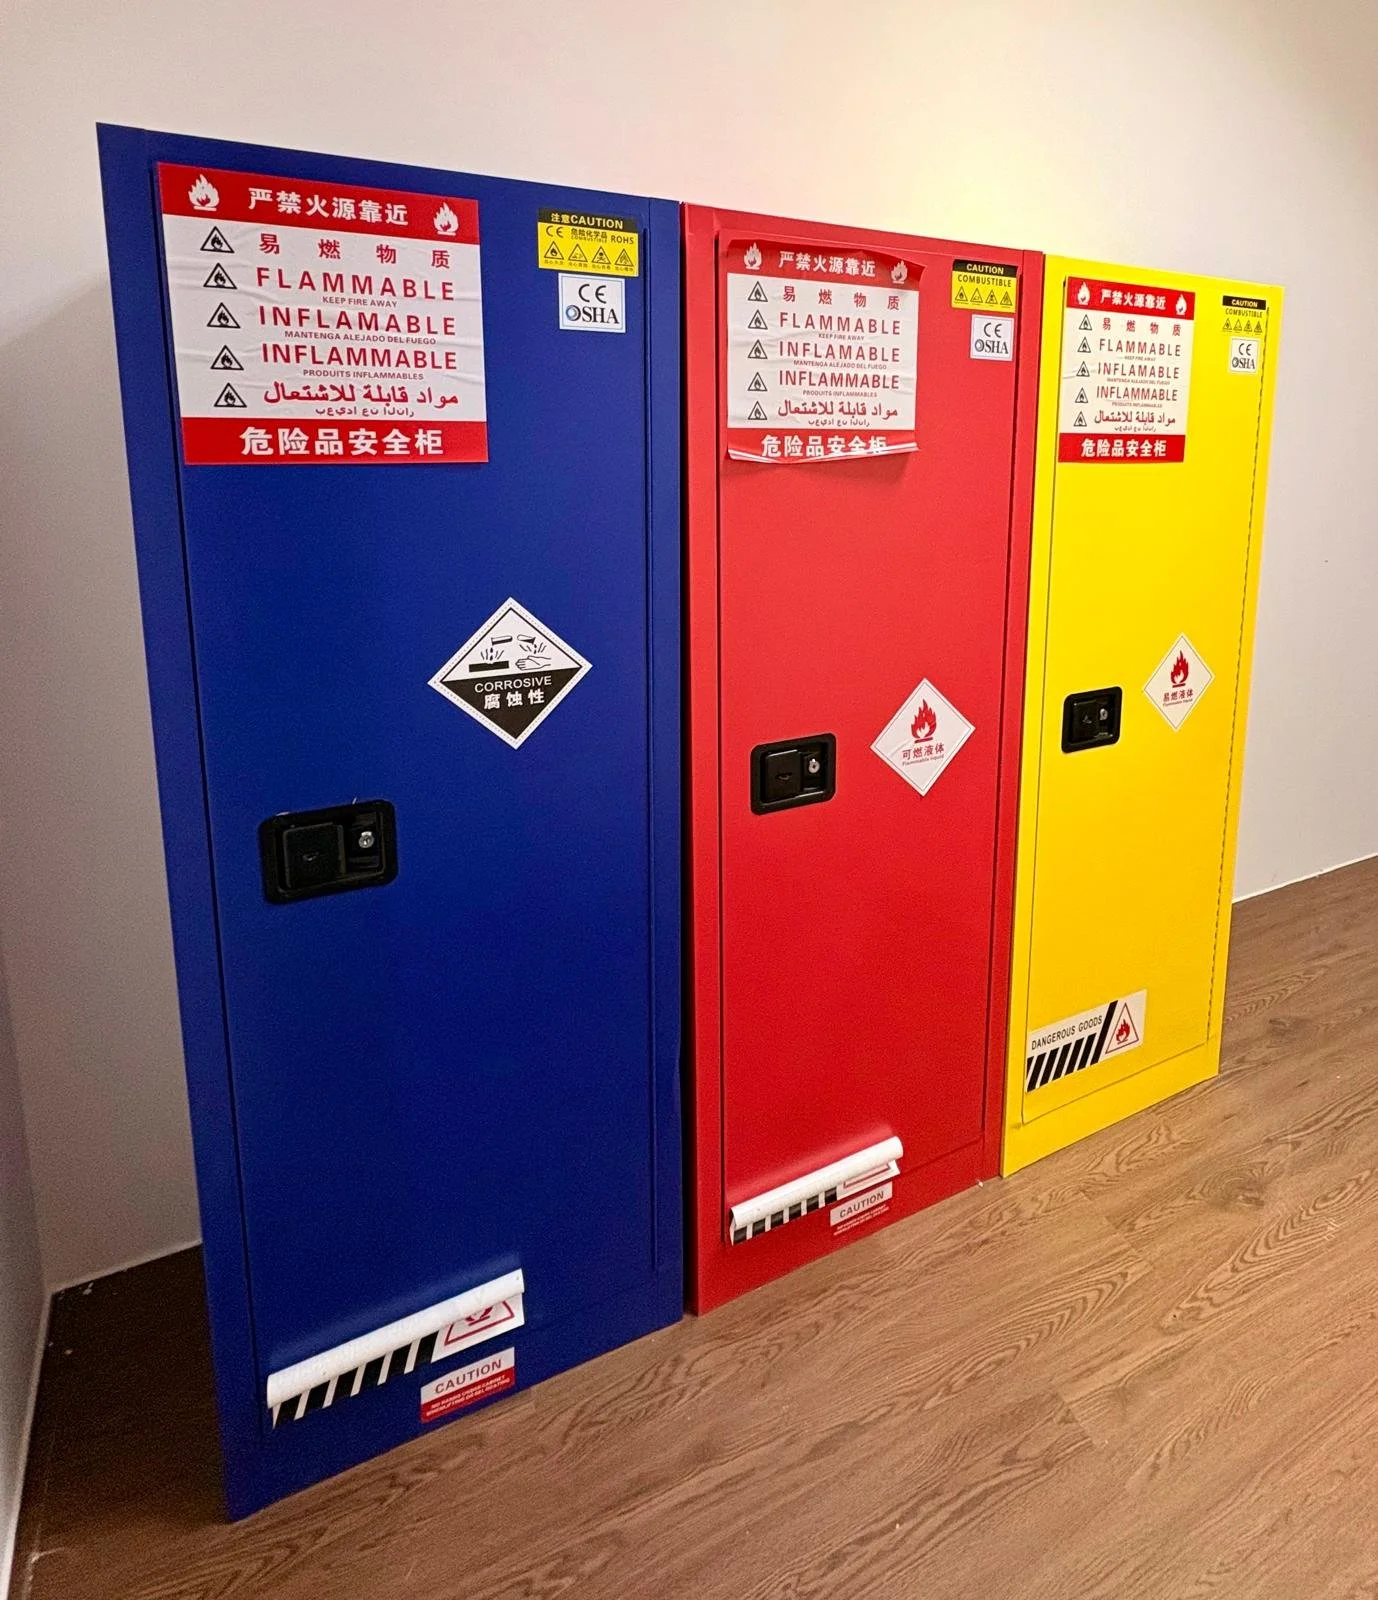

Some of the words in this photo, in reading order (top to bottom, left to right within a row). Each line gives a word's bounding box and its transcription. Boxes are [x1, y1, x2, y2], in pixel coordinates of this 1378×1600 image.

[248, 187, 408, 226] 严禁火源靠近
[611, 235, 634, 245] ROHS
[778, 250, 876, 277] 严禁火源靠近
[966, 263, 1004, 276] CAUTION
[256, 266, 454, 301] FLAMMABLE
[957, 274, 1012, 288] COMBUSTIBLE
[322, 296, 346, 305] KEEP
[348, 297, 368, 306] FIRE
[370, 299, 398, 308] AWAY
[578, 283, 607, 304] CE
[1100, 288, 1166, 310] 严禁火源靠近
[1231, 299, 1258, 308] CAUTION
[259, 305, 456, 336] INFLAMABLE
[565, 305, 619, 324] OSHA
[779, 311, 901, 335] FLAMMABLE
[284, 330, 341, 341] MANTENGA
[343, 332, 386, 344] ALEJADO
[387, 335, 405, 344] DEL
[406, 336, 436, 346] FUEGO
[983, 322, 1002, 338] CE
[779, 341, 900, 362] INFLAMABLE
[974, 339, 1009, 354] OSHA
[1099, 338, 1181, 357] FLAMMABLE
[1238, 342, 1252, 356] CE
[262, 343, 457, 370] INFLAMMABLE
[1231, 357, 1256, 370] OSHA
[303, 369, 351, 379] PRODUITS
[353, 370, 424, 381] INFLAMMABLES
[779, 370, 899, 389] INFLAMMABLE
[1098, 362, 1180, 379] INFLAMABLE
[263, 381, 355, 404] للاشتعال
[363, 384, 409, 407] قابلة
[416, 386, 459, 408] مواد
[1096, 385, 1178, 402] INFLAMMABLE
[778, 399, 834, 417] للاشتعال
[839, 400, 866, 418] قابلة
[871, 403, 898, 420] مواد
[239, 425, 444, 456] 危险品安全柜
[1081, 438, 1167, 457] 危险品安全柜
[474, 675, 552, 693] CORROSIVE
[484, 688, 545, 710] 腐蚀性
[902, 742, 945, 760] 可燃液体
[1031, 1025, 1076, 1051] DANGEROUS
[1078, 1015, 1103, 1033] GOODS
[839, 1190, 884, 1219] CAUTION
[434, 1358, 501, 1395] CAUTION
